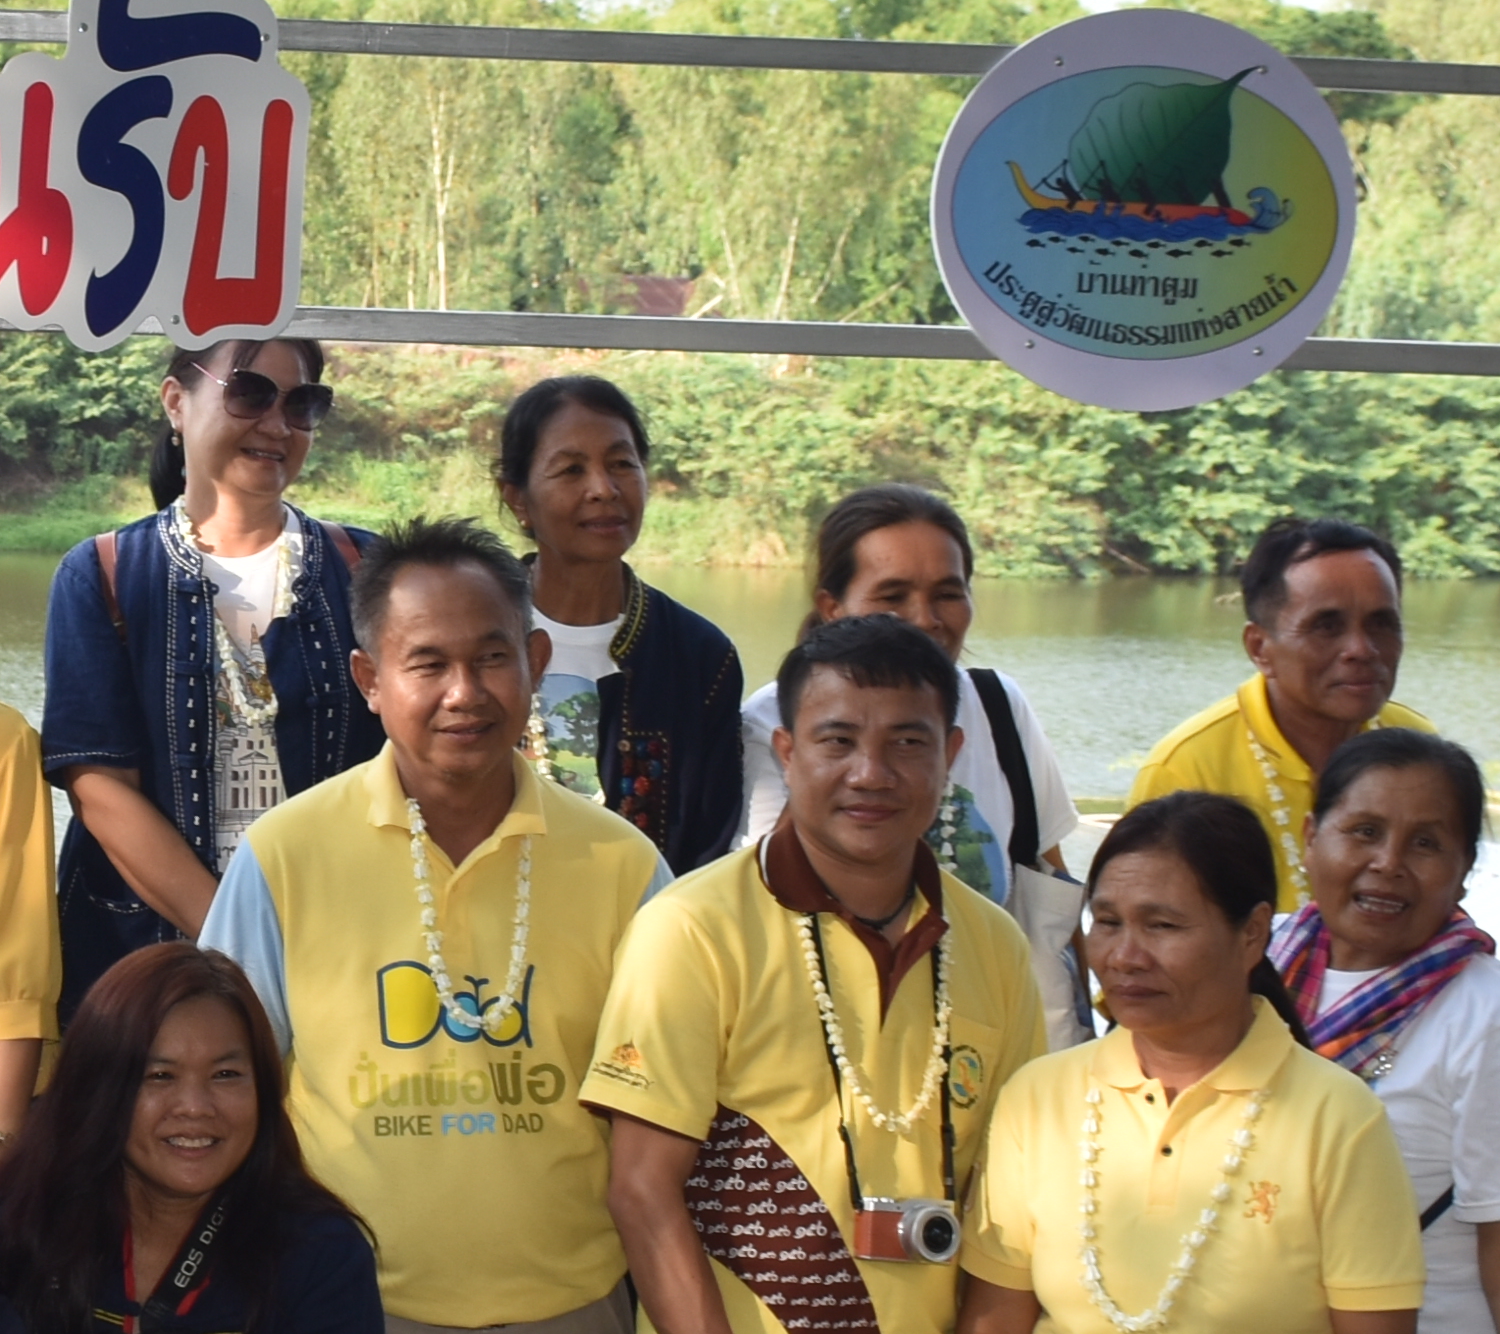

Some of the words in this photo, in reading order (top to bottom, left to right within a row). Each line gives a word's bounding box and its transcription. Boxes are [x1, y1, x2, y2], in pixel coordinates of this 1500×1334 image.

[1077, 259, 1198, 306] บ้านท่าตูม
[348, 1048, 566, 1110] ปั่นเพื่อพ่อ
[374, 1114, 432, 1136] BIKE
[441, 1112, 497, 1135] FOR
[502, 1113, 544, 1134] DAD
[174, 1248, 204, 1288] EOS
